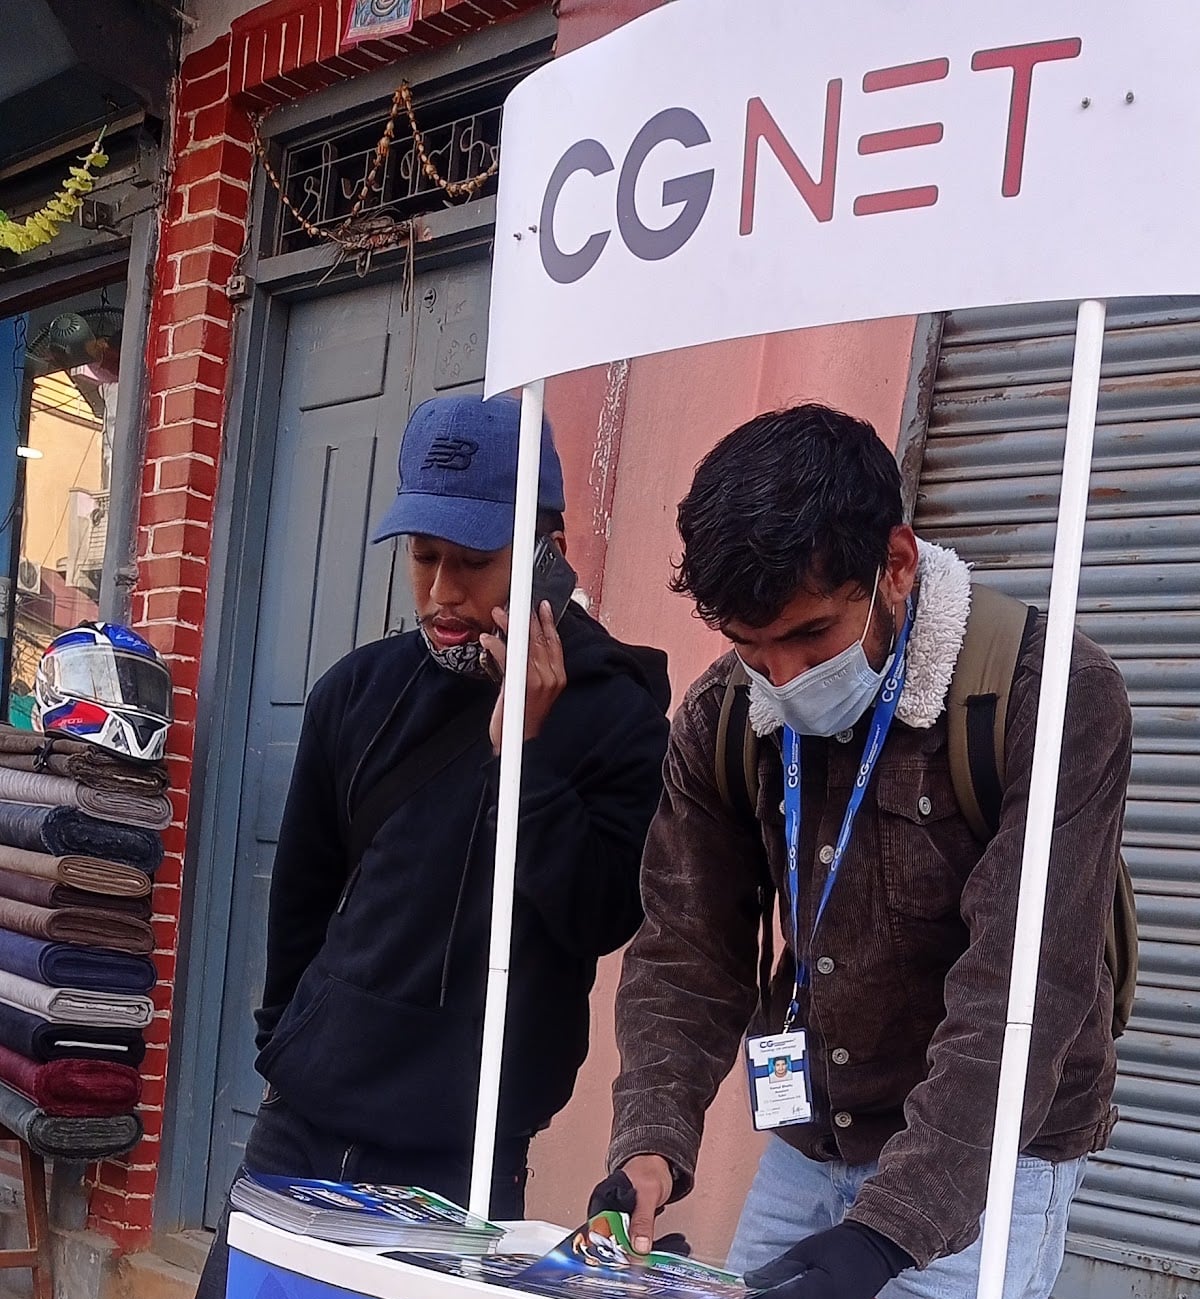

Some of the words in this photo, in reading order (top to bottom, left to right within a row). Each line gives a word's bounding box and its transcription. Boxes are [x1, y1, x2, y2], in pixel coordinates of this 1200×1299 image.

[539, 107, 714, 284] CG
[739, 37, 1081, 236] NET
[882, 678, 898, 702] CG
[788, 764, 798, 788] CG
[857, 763, 870, 788] CG
